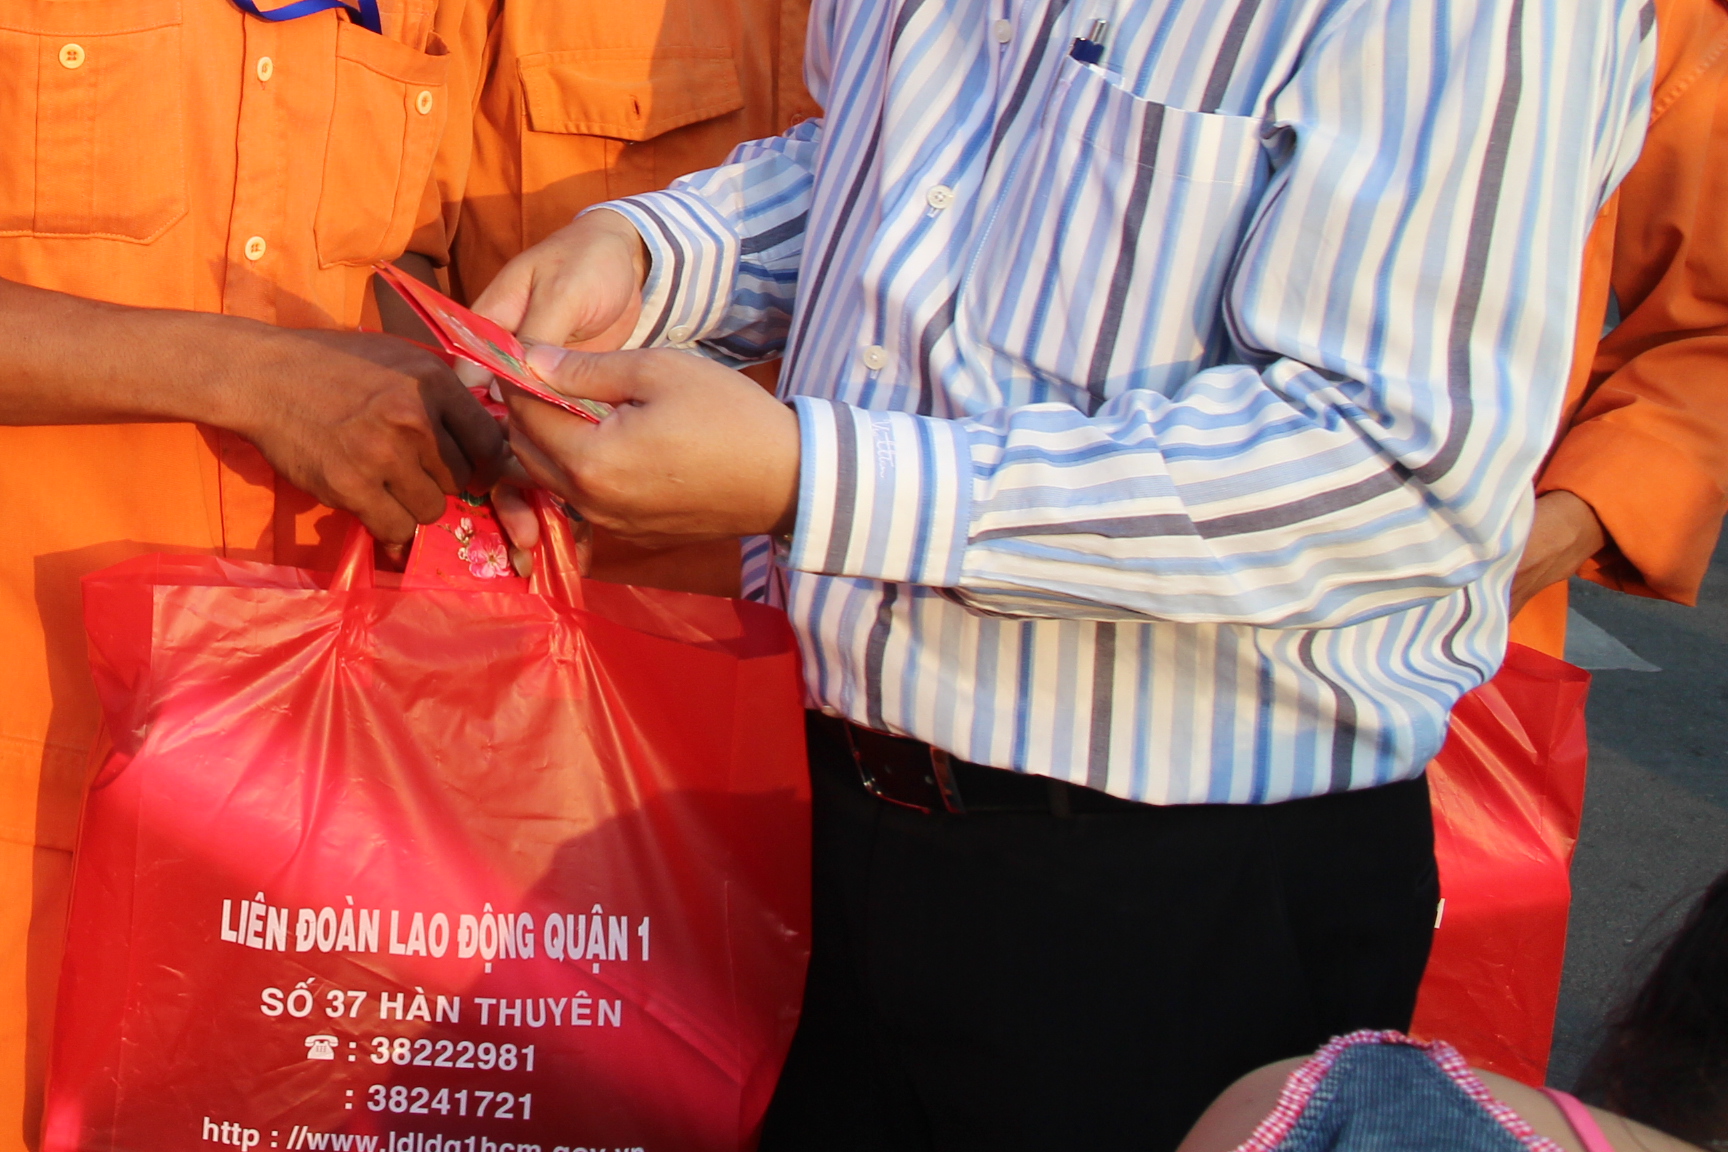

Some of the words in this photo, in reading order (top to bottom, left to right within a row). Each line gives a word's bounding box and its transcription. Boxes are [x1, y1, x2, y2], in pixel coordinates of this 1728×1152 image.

[221, 891, 289, 952] LIÊN
[295, 895, 380, 953] ĐOÀN
[389, 909, 450, 958] LAO
[457, 902, 535, 974] ĐỘNG
[543, 903, 628, 974] QUẬN
[637, 916, 650, 961] 1
[260, 977, 315, 1018] SỐ
[325, 989, 367, 1018] 37
[379, 986, 460, 1023] HÀN
[474, 990, 622, 1027] THUYÊN
[370, 1036, 535, 1072] 38222981
[367, 1084, 532, 1120] 38241721
[202, 1116, 260, 1152] http
